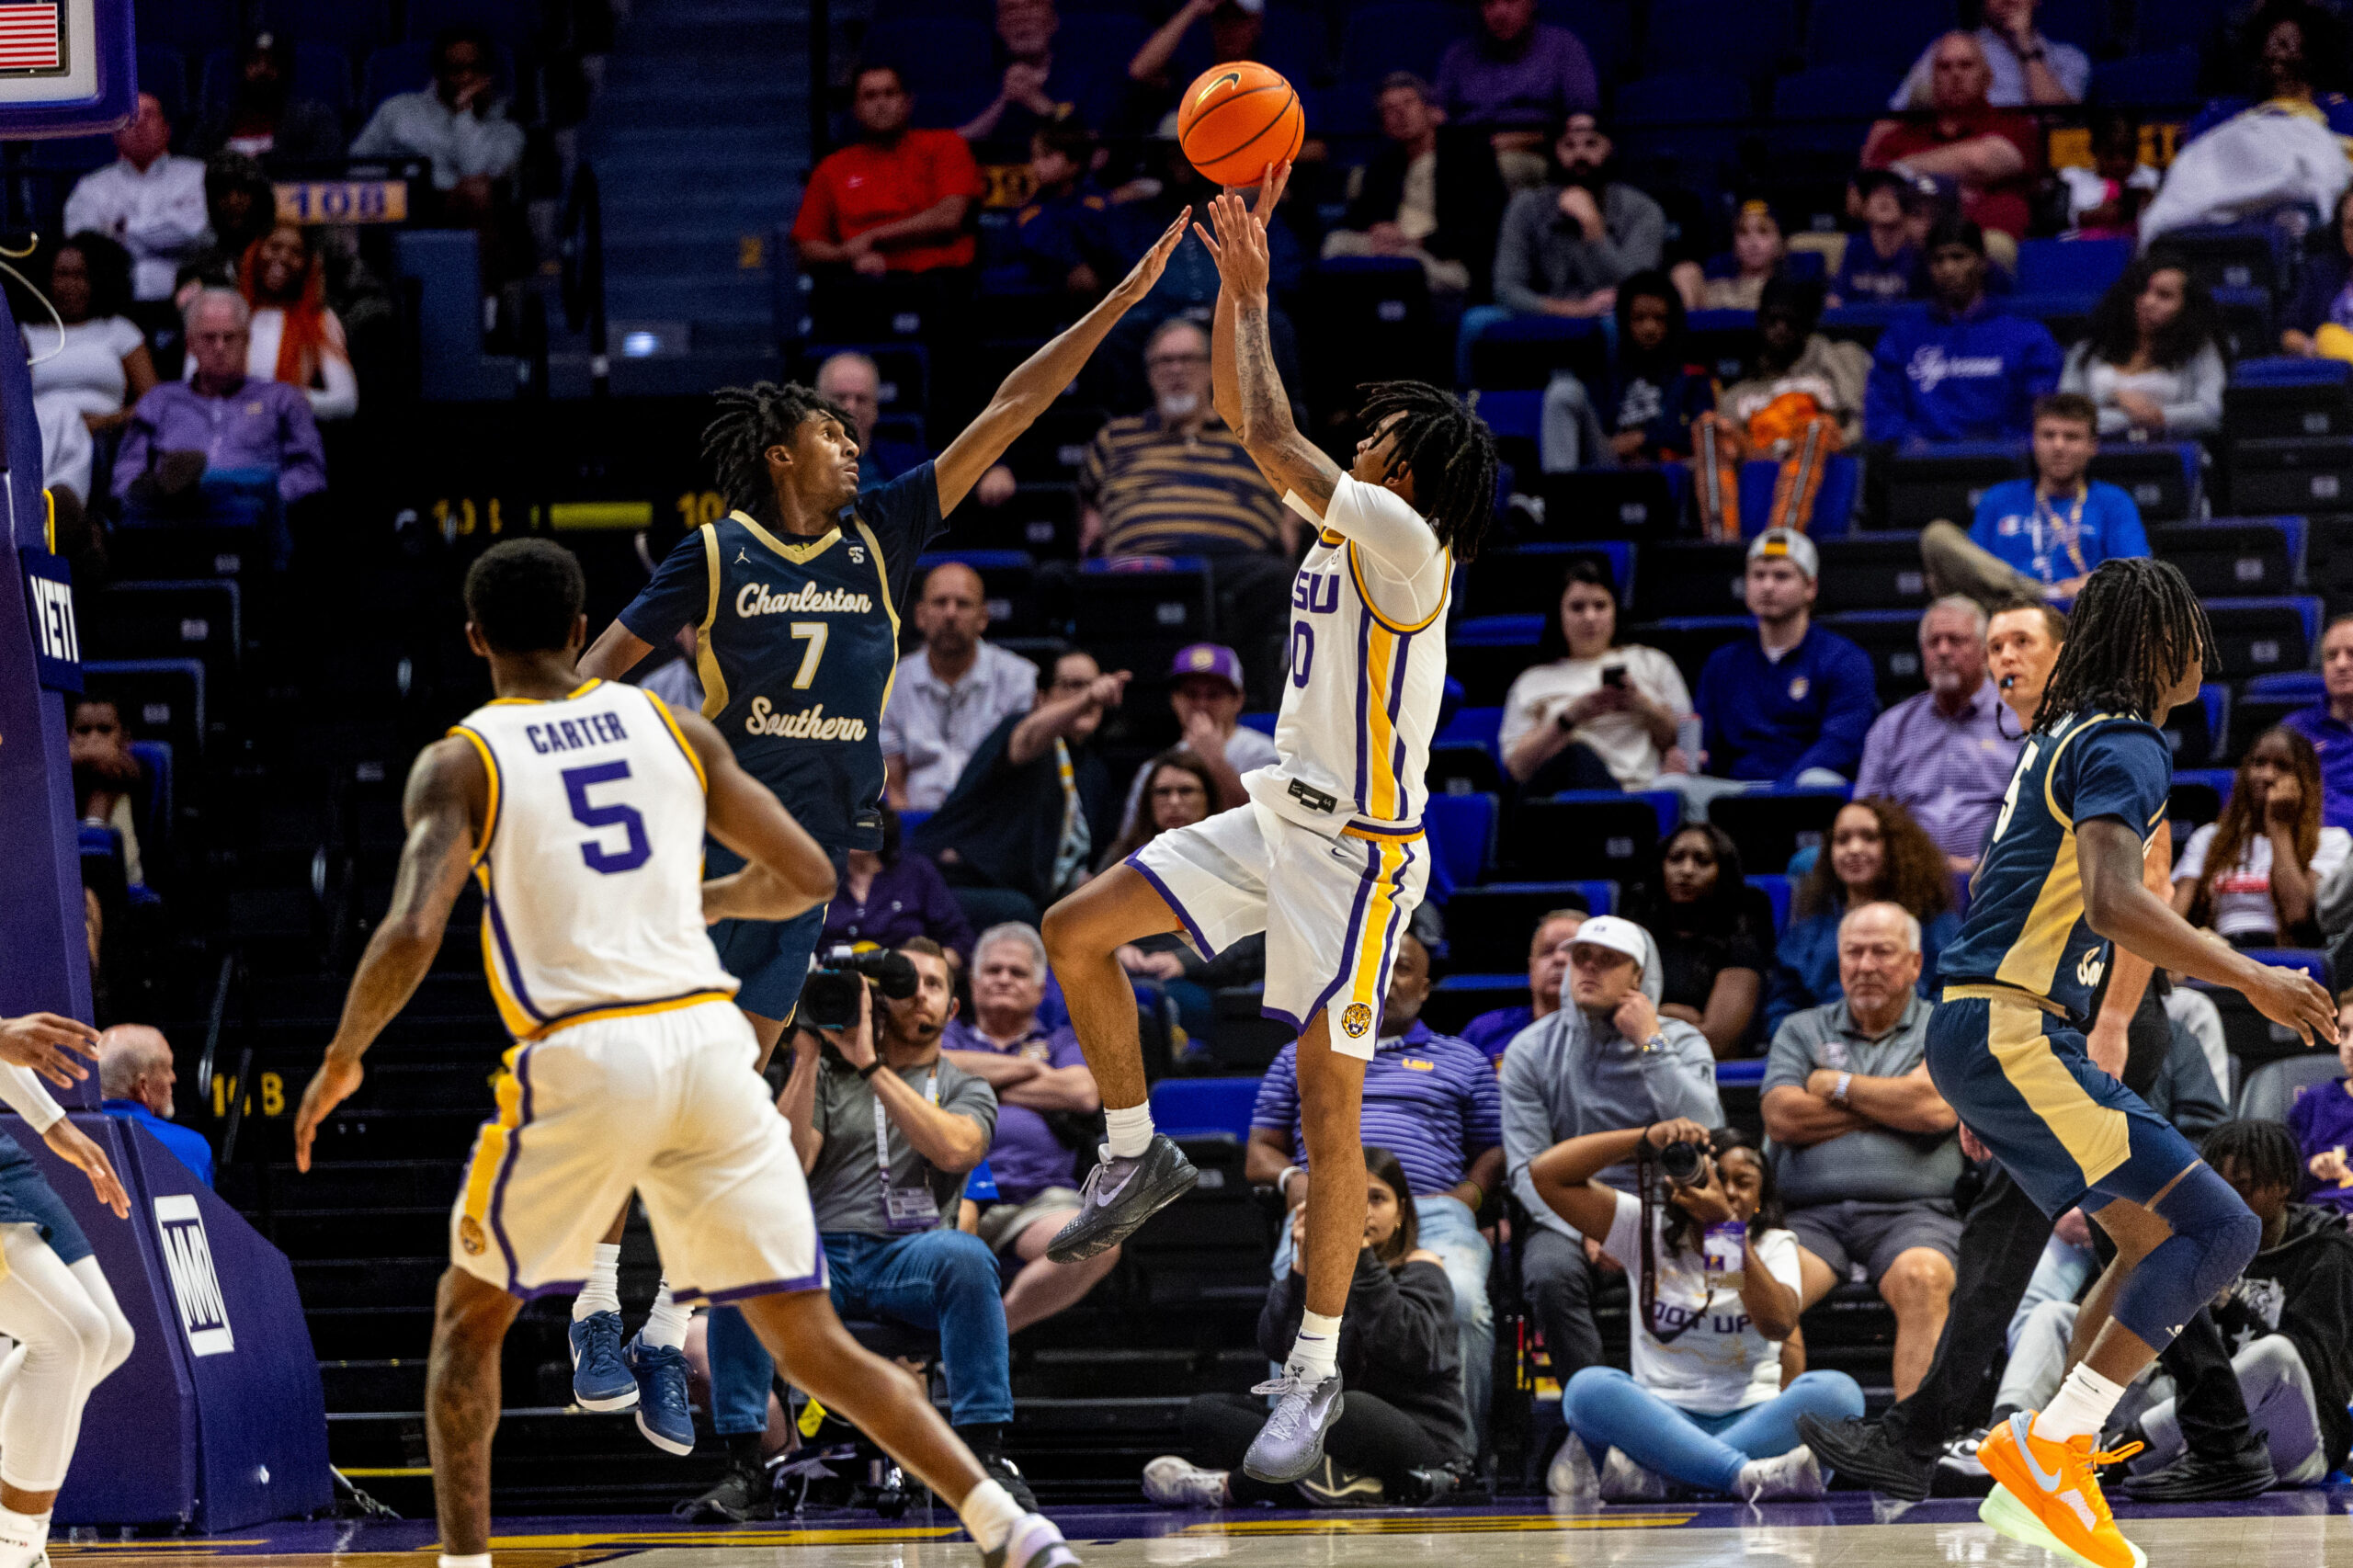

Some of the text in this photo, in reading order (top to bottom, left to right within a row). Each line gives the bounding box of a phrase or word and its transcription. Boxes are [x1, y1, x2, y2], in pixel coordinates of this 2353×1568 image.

[30, 574, 79, 664] YETI
[736, 580, 872, 618] Charleston
[1291, 570, 1340, 614] SU
[790, 621, 828, 689] 7
[1292, 620, 1314, 688] 0
[526, 711, 629, 755] CARTER
[745, 696, 867, 742] Southern
[561, 758, 653, 876] 5
